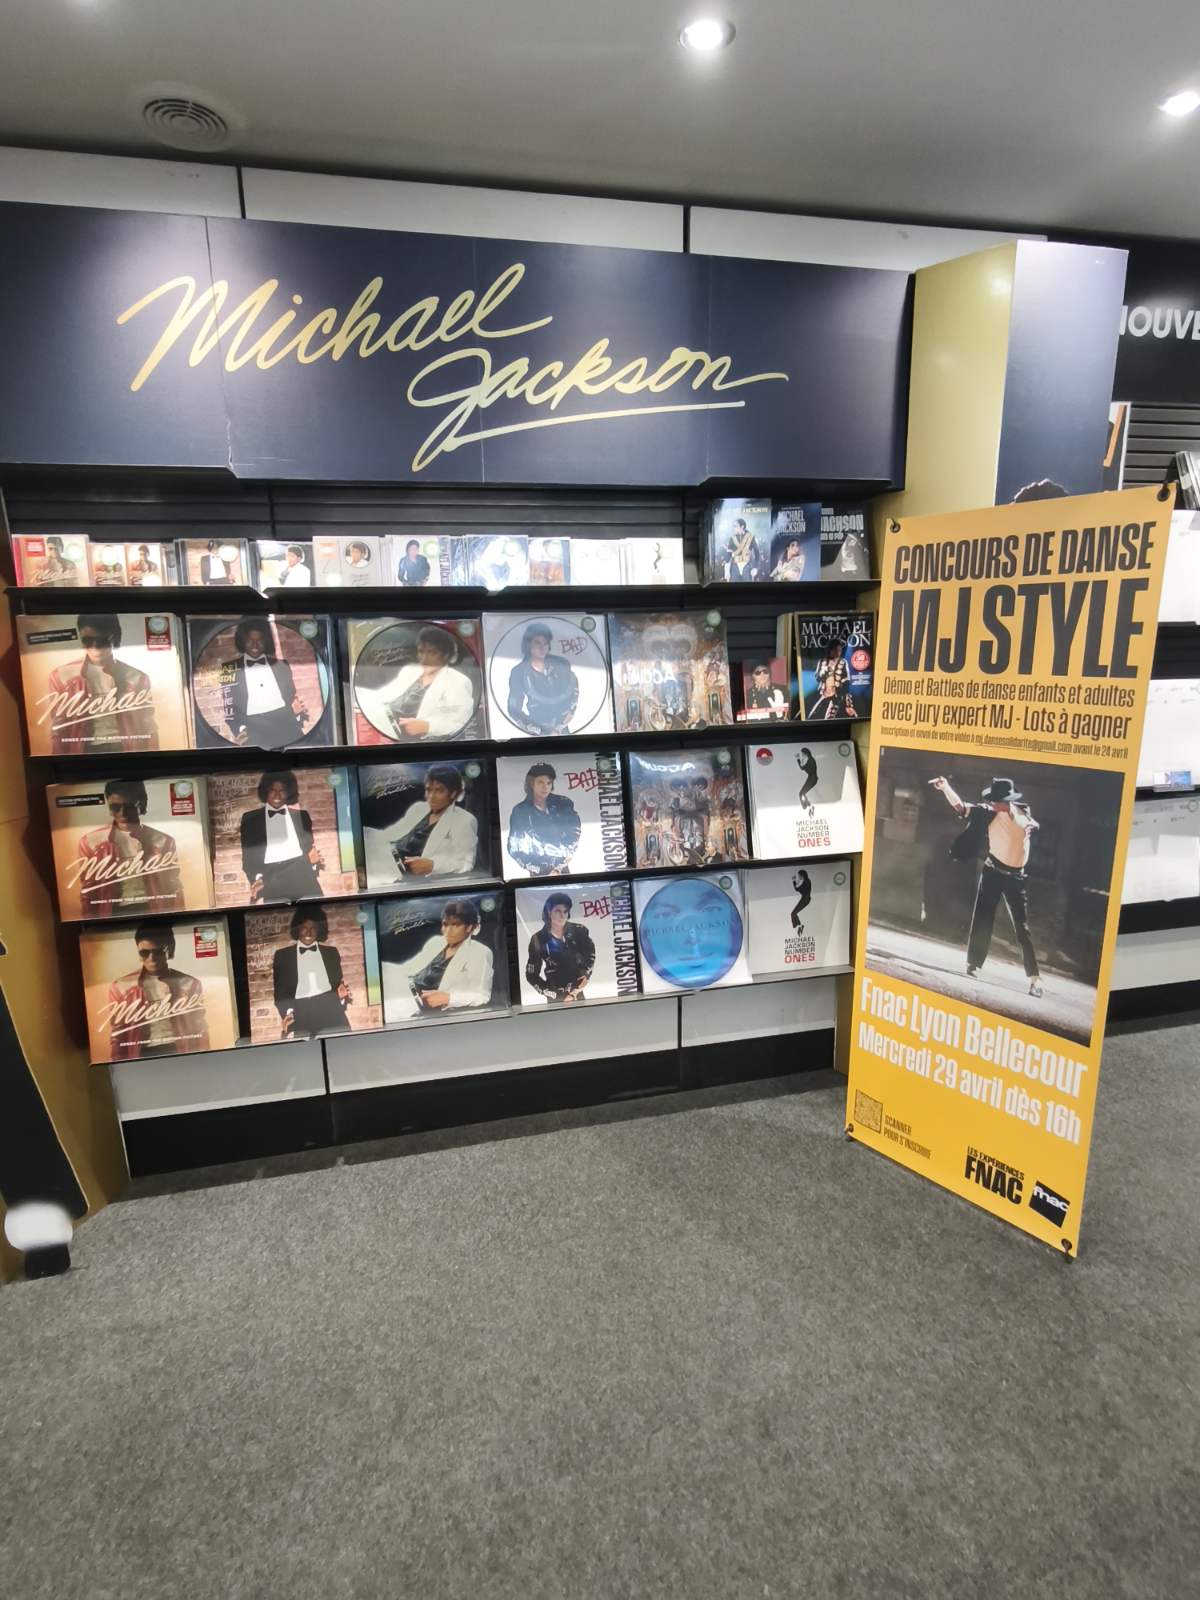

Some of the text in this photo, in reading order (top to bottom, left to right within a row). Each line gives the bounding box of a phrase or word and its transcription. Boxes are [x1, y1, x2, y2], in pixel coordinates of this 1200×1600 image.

[118, 263, 552, 391] Michael
[407, 338, 789, 471] Jackson
[821, 515, 863, 531] ACKSON
[894, 521, 1157, 584] CONCOURS DE DANSE
[801, 620, 872, 636] MICHAEL
[887, 577, 1149, 678] MJ STYLE
[558, 636, 588, 655] BAD
[883, 676, 912, 695] Démo
[914, 678, 924, 696] et
[926, 678, 964, 698] Battles
[966, 680, 980, 699] de
[981, 680, 1016, 701] danse
[1018, 682, 1066, 704] enfants
[1068, 684, 1082, 704] et
[1084, 684, 1135, 708] adultes
[882, 701, 912, 721] avec
[914, 700, 940, 727] jury
[942, 703, 988, 729] expert
[989, 704, 1014, 729] MJ
[1024, 706, 1056, 733] Lots
[1058, 708, 1068, 734] à
[1071, 712, 1132, 741] gagner
[1101, 745, 1110, 757] 24
[595, 752, 628, 871] MCHAEL JACKSON
[798, 838, 831, 848] ONES
[611, 882, 638, 996] MCHAEL JACKSON
[784, 936, 815, 944] MICHAEL
[784, 942, 815, 950] JACKSON
[784, 947, 815, 956] NUMBER
[784, 954, 816, 964] ONES
[860, 976, 1088, 1098] Fnac Lyon Bellecour
[858, 1021, 1082, 1145] Mercredi 29 avril dès 16h
[884, 1114, 912, 1136] SCANNER
[884, 1127, 899, 1144] POUR
[967, 1146, 978, 1158] LES
[964, 1154, 1023, 1205] FNAC
[1033, 1186, 1070, 1212] fnac
